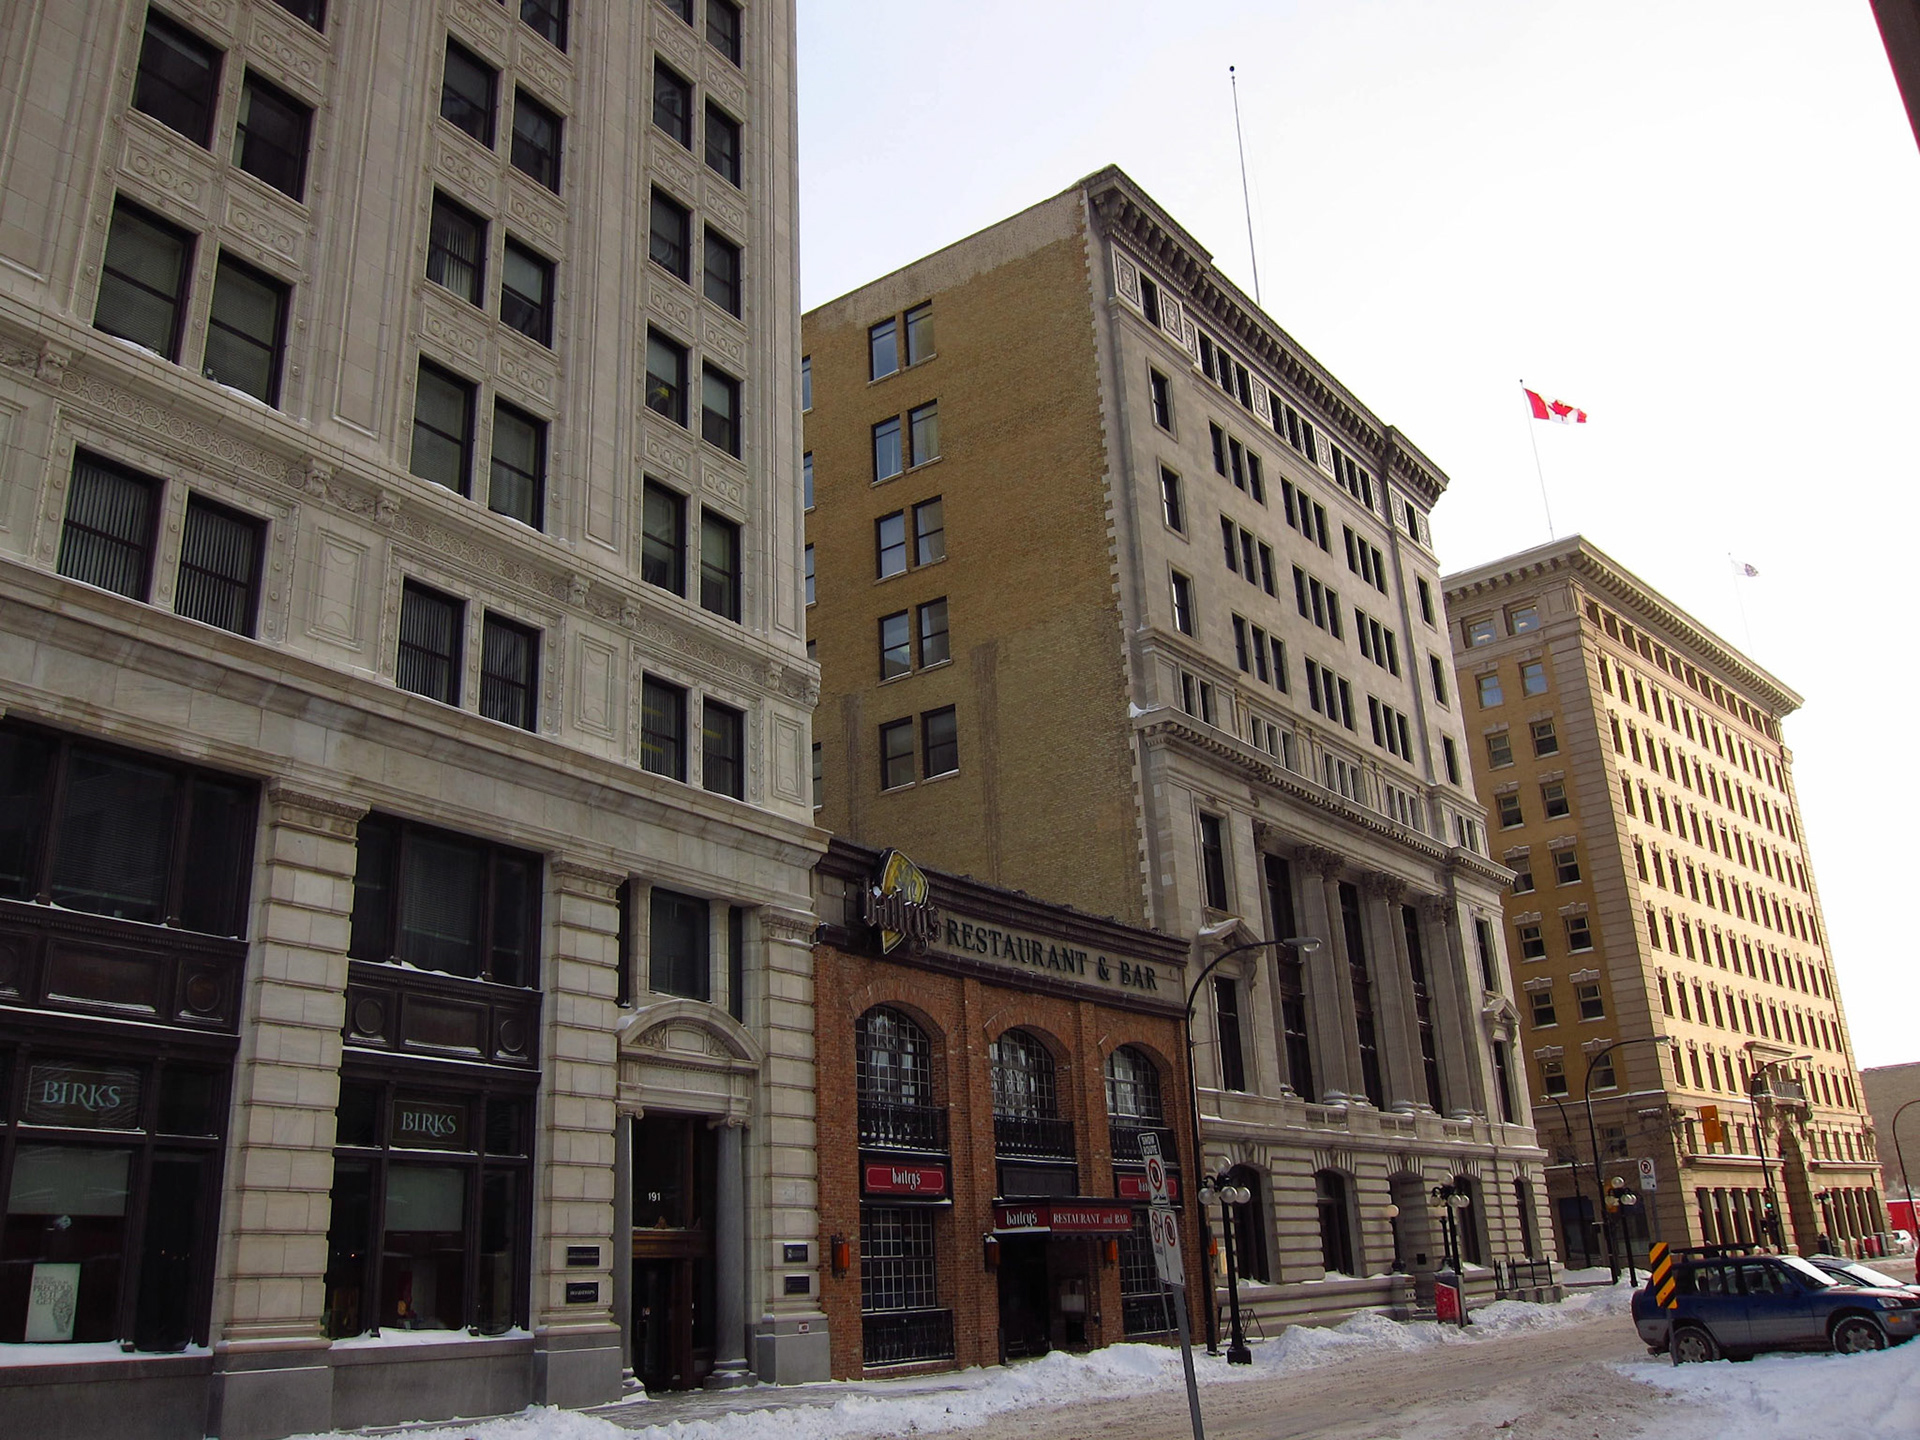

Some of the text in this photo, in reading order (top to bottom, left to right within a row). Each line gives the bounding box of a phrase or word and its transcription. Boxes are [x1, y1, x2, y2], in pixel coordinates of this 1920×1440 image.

[945, 918, 1159, 991] RESTAURANT & BAR
[41, 1080, 121, 1112] BIRKS
[401, 1111, 457, 1138] BIRKS
[648, 1191, 661, 1202] 191
[1053, 1212, 1100, 1224] RESTAURANT
[1114, 1213, 1129, 1224] BAR
